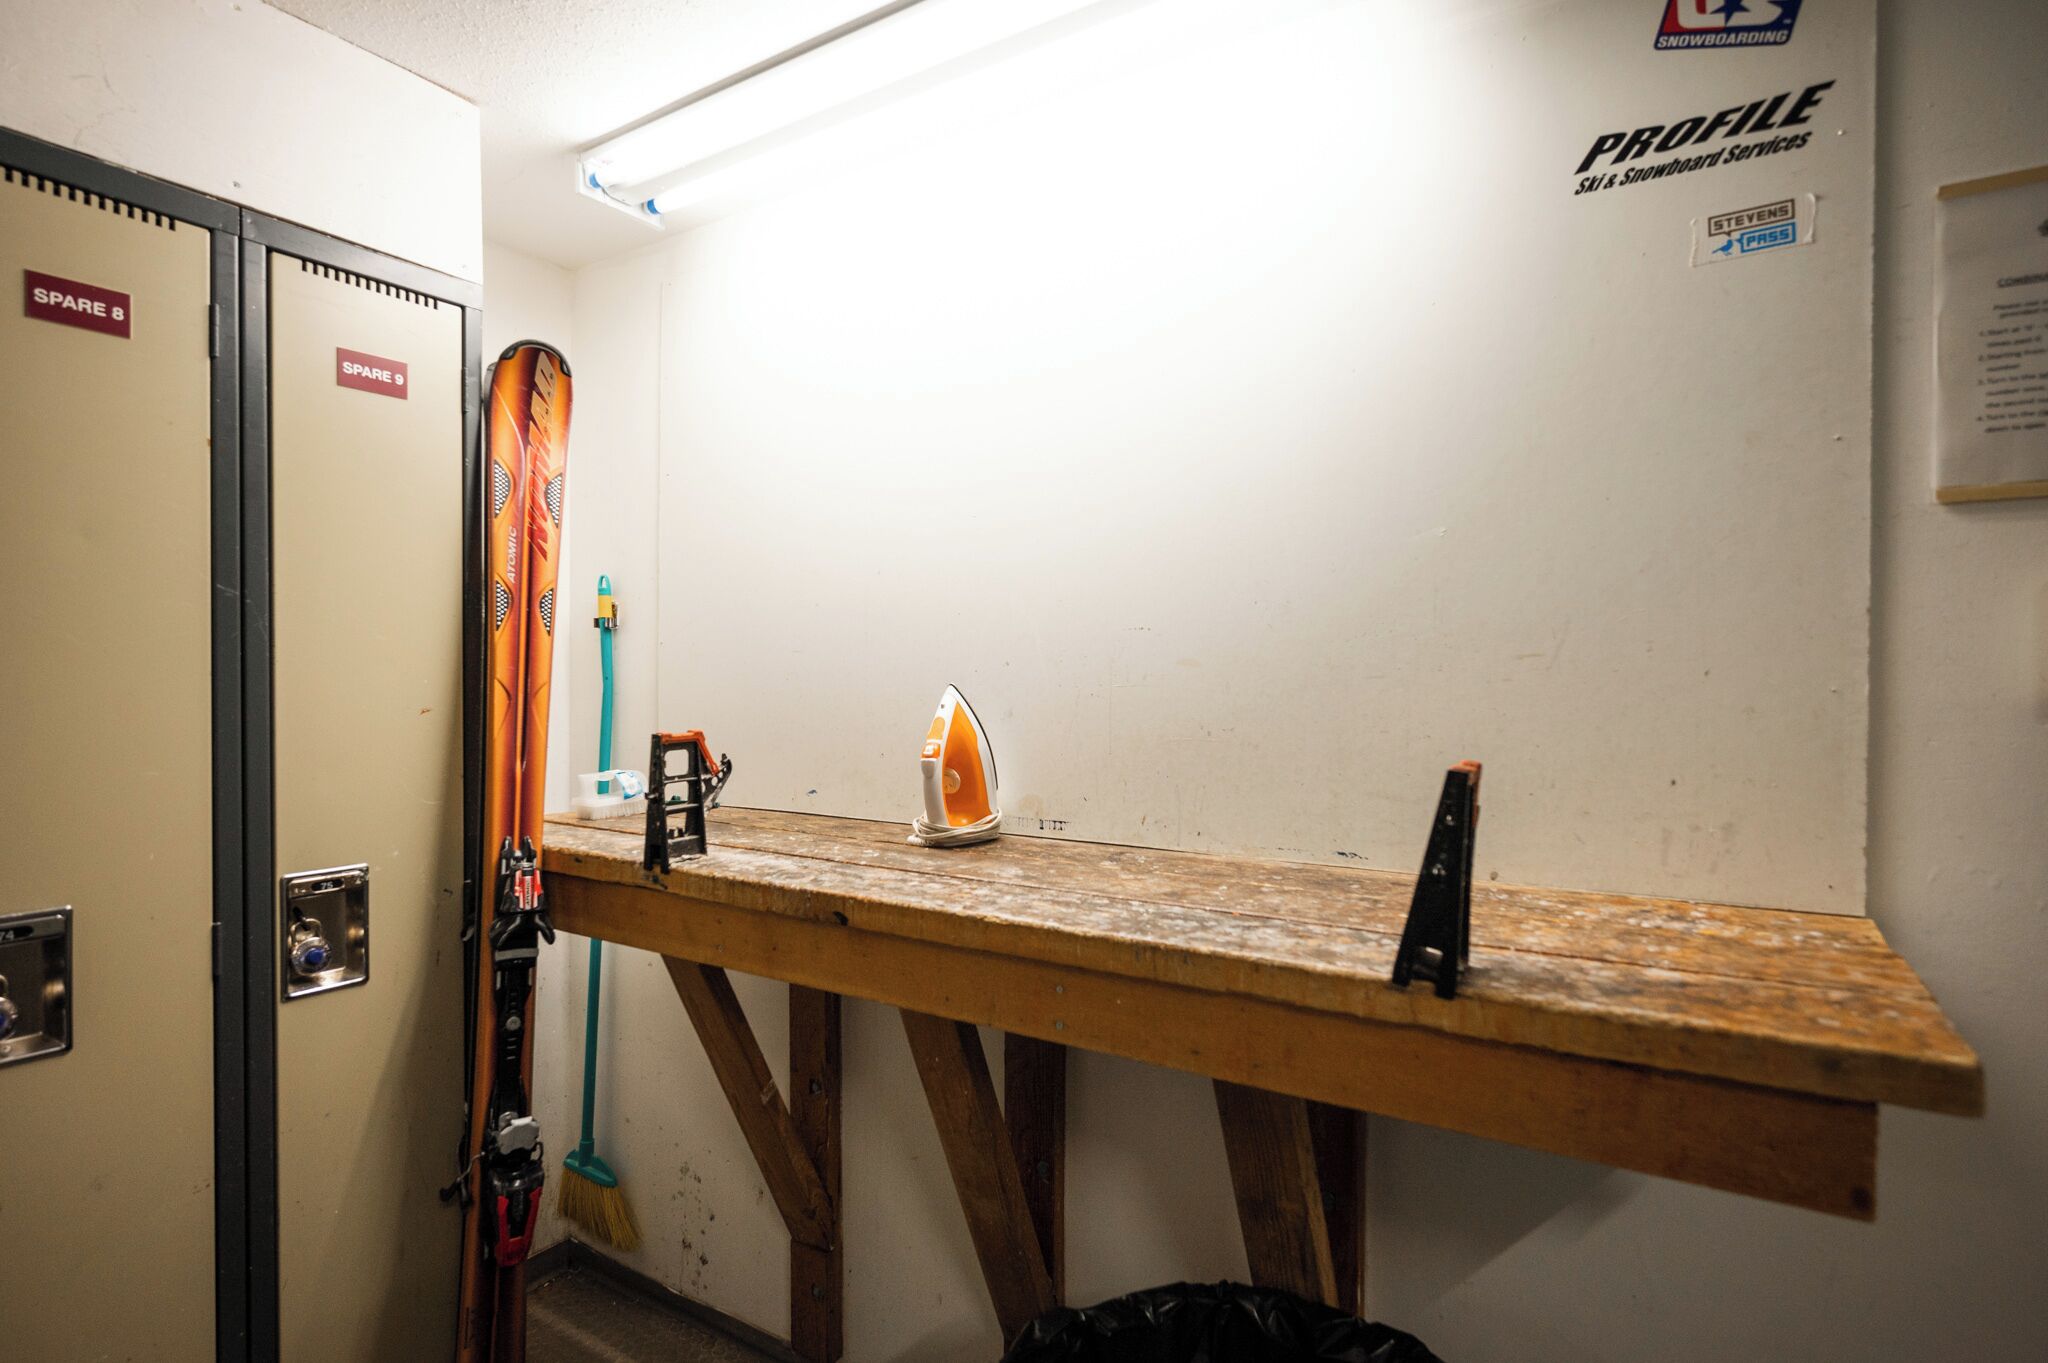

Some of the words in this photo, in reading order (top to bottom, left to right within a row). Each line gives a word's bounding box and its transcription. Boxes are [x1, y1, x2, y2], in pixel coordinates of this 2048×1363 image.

[1657, 30, 1788, 48] SNOWBOARDING
[1574, 79, 1836, 175] PROFILE
[1574, 172, 1608, 195] Ski
[1603, 173, 1617, 190] &
[1619, 148, 1726, 187] Snowboard
[1723, 131, 1813, 165] Services
[1713, 204, 1789, 231] STEVENS
[1746, 228, 1790, 247] PASS
[34, 287, 107, 317] SPARE
[111, 306, 125, 321] 8
[342, 361, 392, 383] SPARE
[394, 373, 404, 386] 9
[505, 526, 518, 584] ATOMIC
